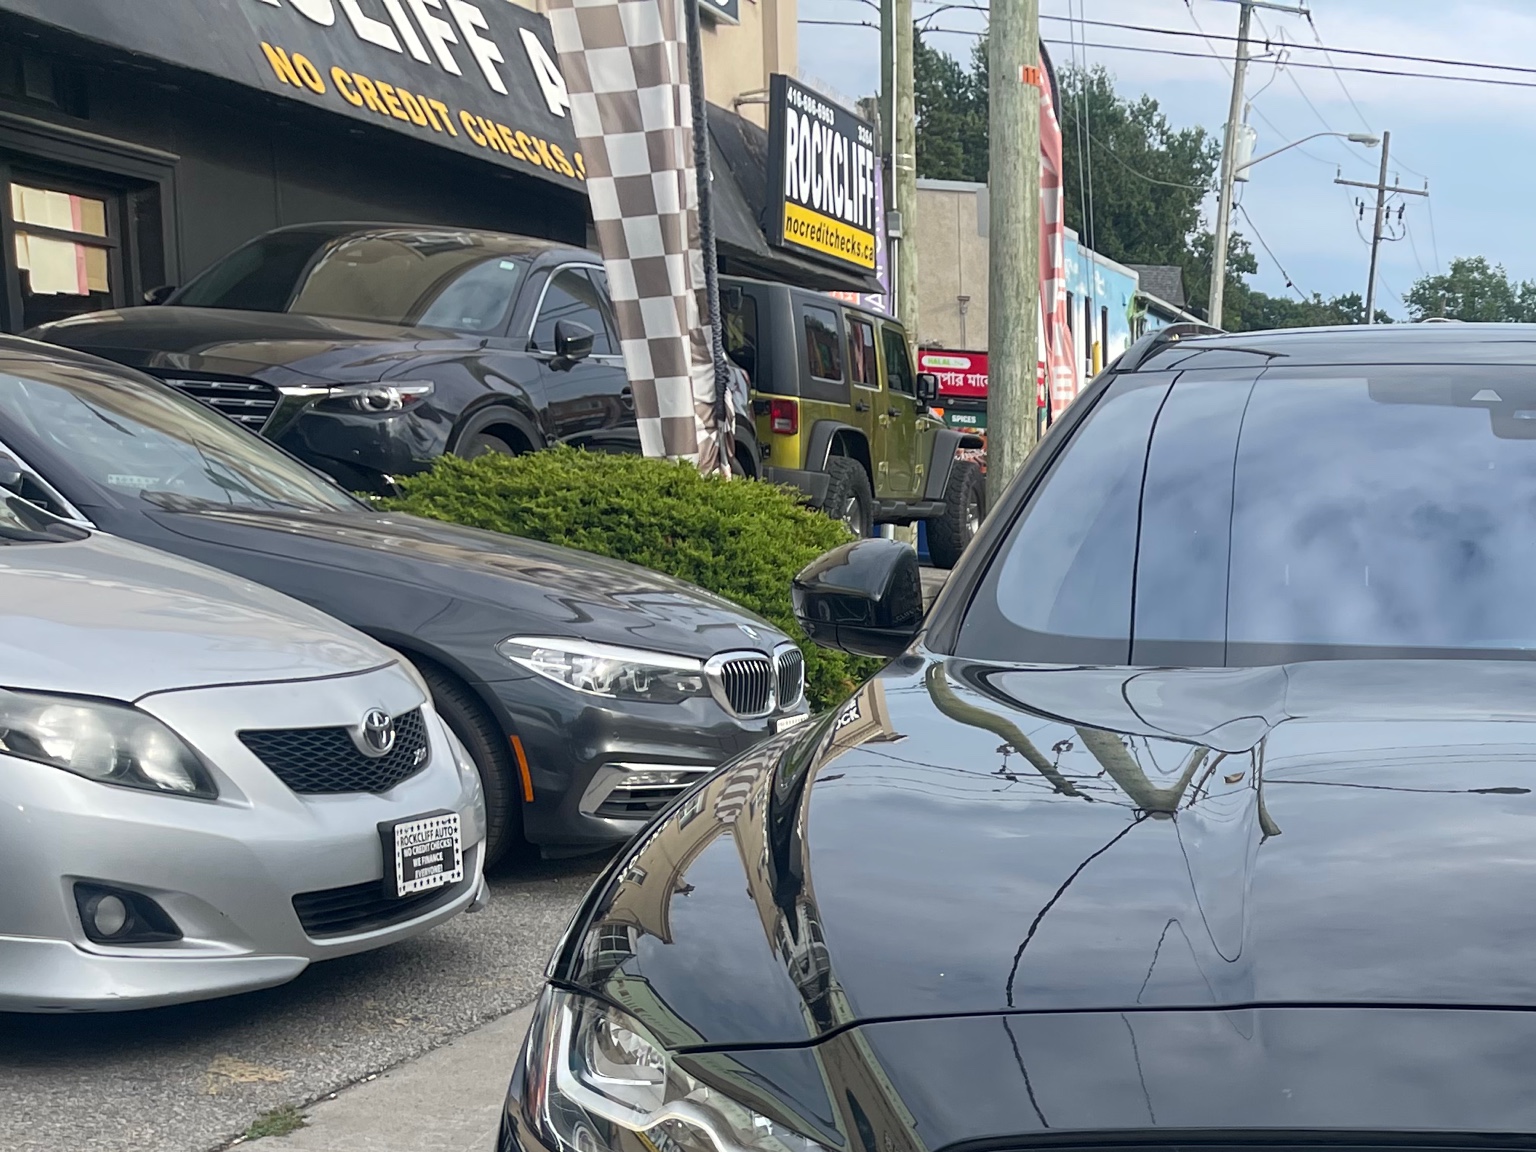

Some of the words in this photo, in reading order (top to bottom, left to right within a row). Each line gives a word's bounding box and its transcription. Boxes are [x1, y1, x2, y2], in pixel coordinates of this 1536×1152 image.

[260, 41, 325, 94] NO
[330, 66, 458, 137] CREDIT
[785, 107, 874, 230] ROCKCLIFF
[786, 213, 874, 261] nocreditchecks.ca
[951, 414, 977, 424] SPICES
[401, 830, 434, 846] ROCKCLIFF
[435, 826, 453, 837] AUTO
[403, 848, 412, 857] NO
[412, 843, 430, 855] CREDIT
[431, 838, 452, 850] CHECKS!
[413, 857, 421, 867] WE
[422, 852, 443, 865] FINANCE
[415, 864, 443, 879] EVERYONE!
